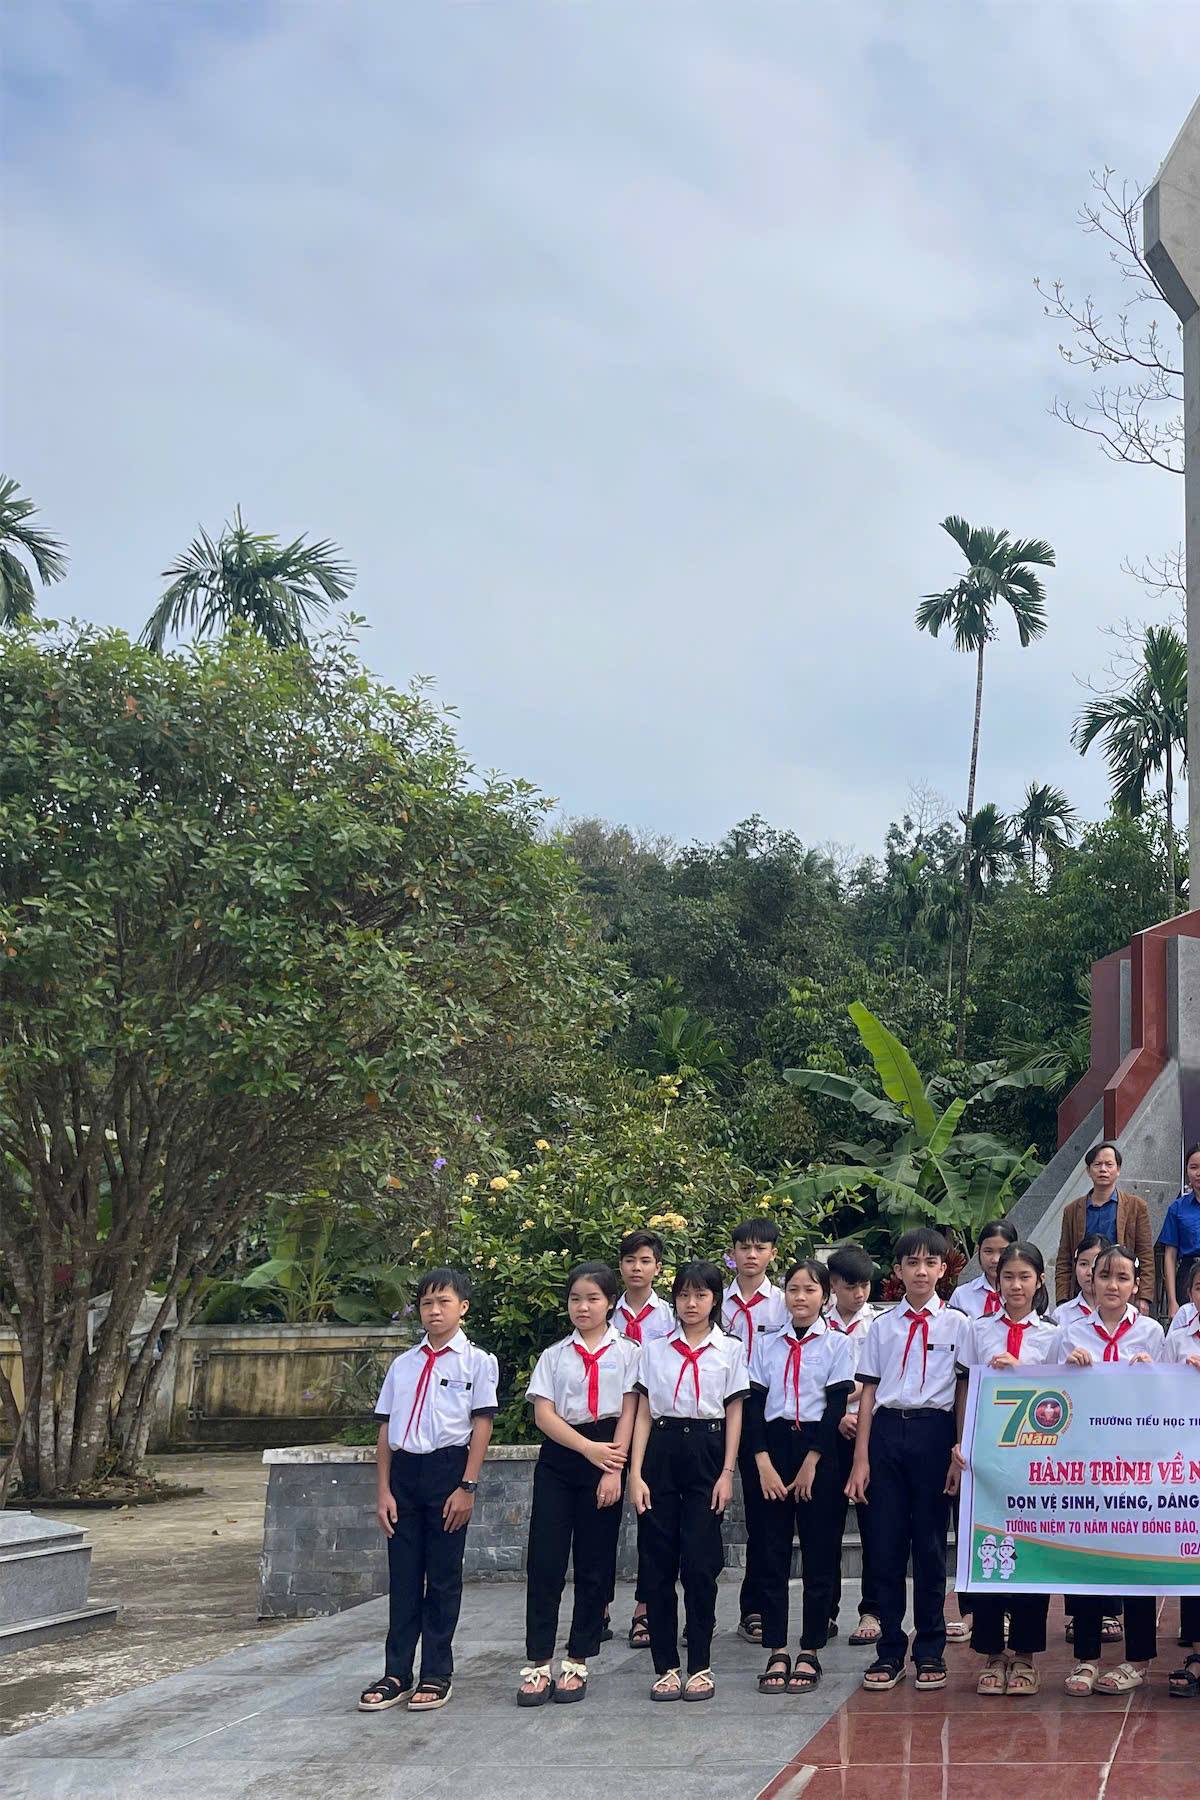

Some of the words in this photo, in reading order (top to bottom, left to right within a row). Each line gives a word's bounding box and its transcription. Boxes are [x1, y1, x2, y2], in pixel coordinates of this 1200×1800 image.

[995, 1389, 1069, 1446] 70
[1089, 1415, 1132, 1426] TRƯỜNG
[1136, 1414, 1160, 1426] TIỂU
[1163, 1417, 1185, 1428] HỌC
[1020, 1432, 1058, 1445] Năm
[1028, 1456, 1085, 1483] HÀNH
[1089, 1456, 1152, 1484] TRÌNH
[1157, 1452, 1184, 1483] VỀ
[1007, 1495, 1037, 1512] DỌN
[1040, 1493, 1057, 1512] VỆ
[1061, 1495, 1099, 1512] SINH,
[1104, 1491, 1153, 1512] VIẾNG,
[1157, 1492, 1199, 1508] DÂNG
[1006, 1517, 1037, 1533] TƯỞNG
[1040, 1518, 1065, 1536] NIỆM
[1069, 1521, 1081, 1533] 70
[1084, 1518, 1108, 1533] NĂM
[1111, 1518, 1139, 1533] NGÀY
[1175, 1518, 1199, 1535] BÀO,
